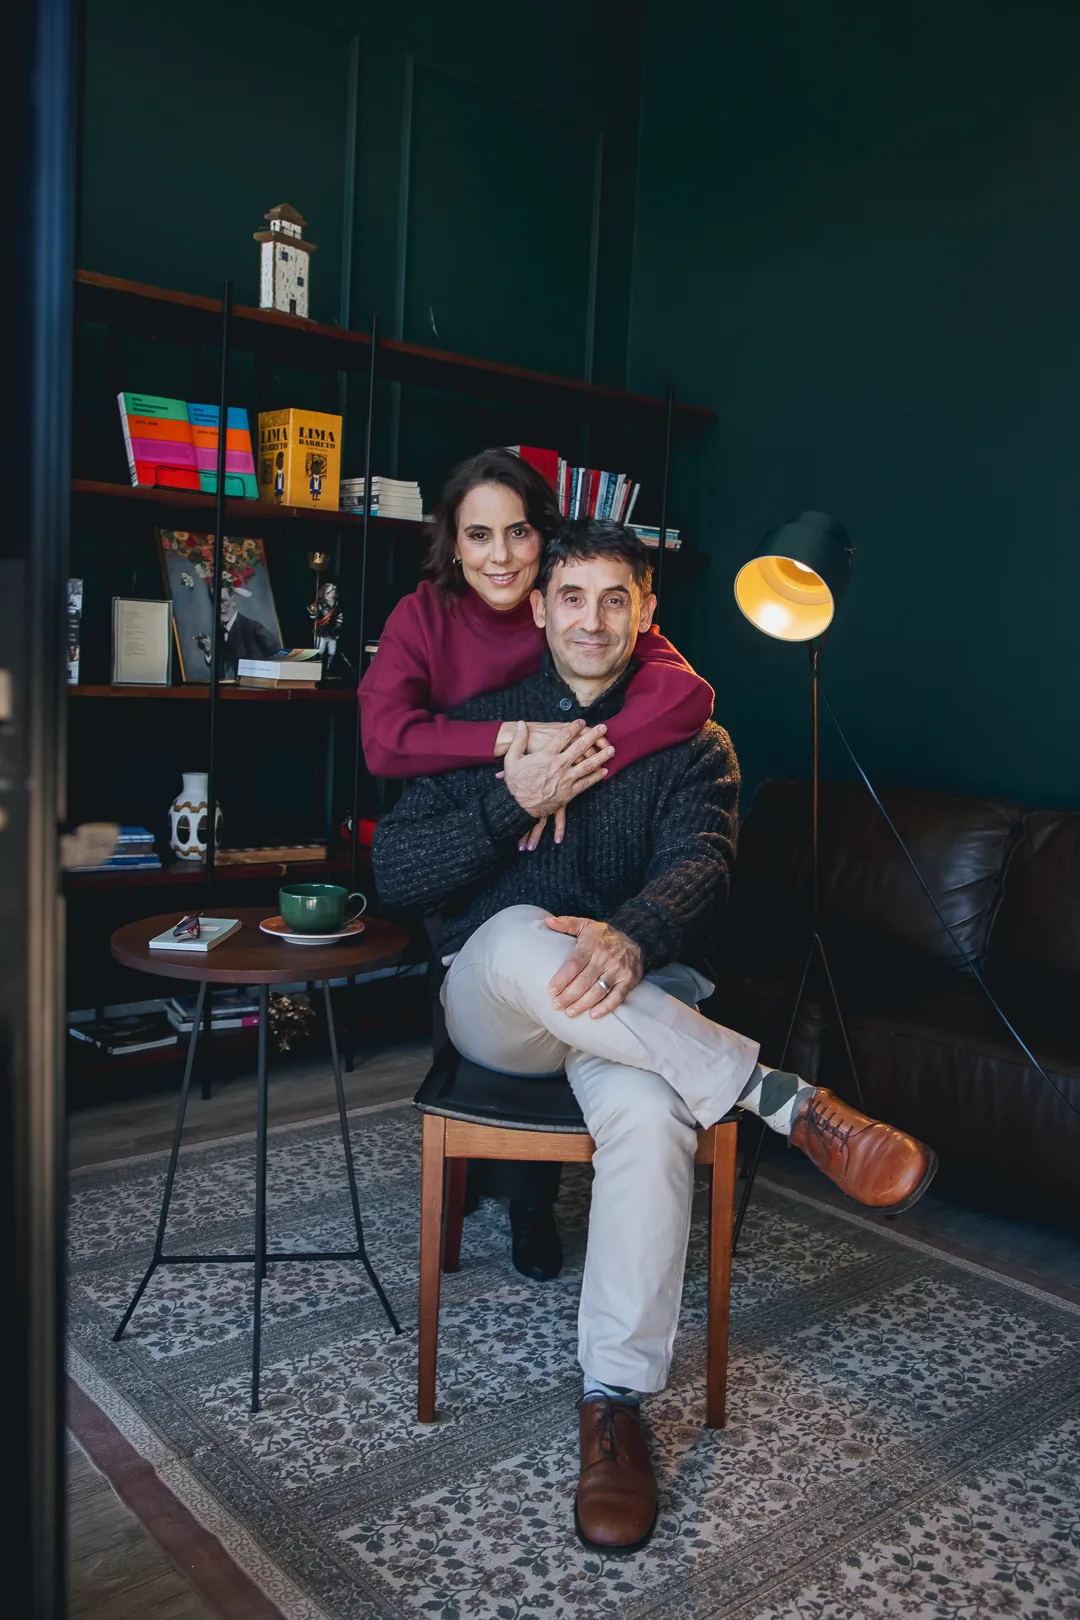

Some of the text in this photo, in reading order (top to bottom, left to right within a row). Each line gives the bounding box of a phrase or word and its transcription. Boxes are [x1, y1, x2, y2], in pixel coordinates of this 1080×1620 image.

[261, 427, 288, 444] LIMA
[299, 426, 336, 443] LIMA
[260, 442, 288, 453] BARRETO
[298, 438, 336, 449] BARRETO
